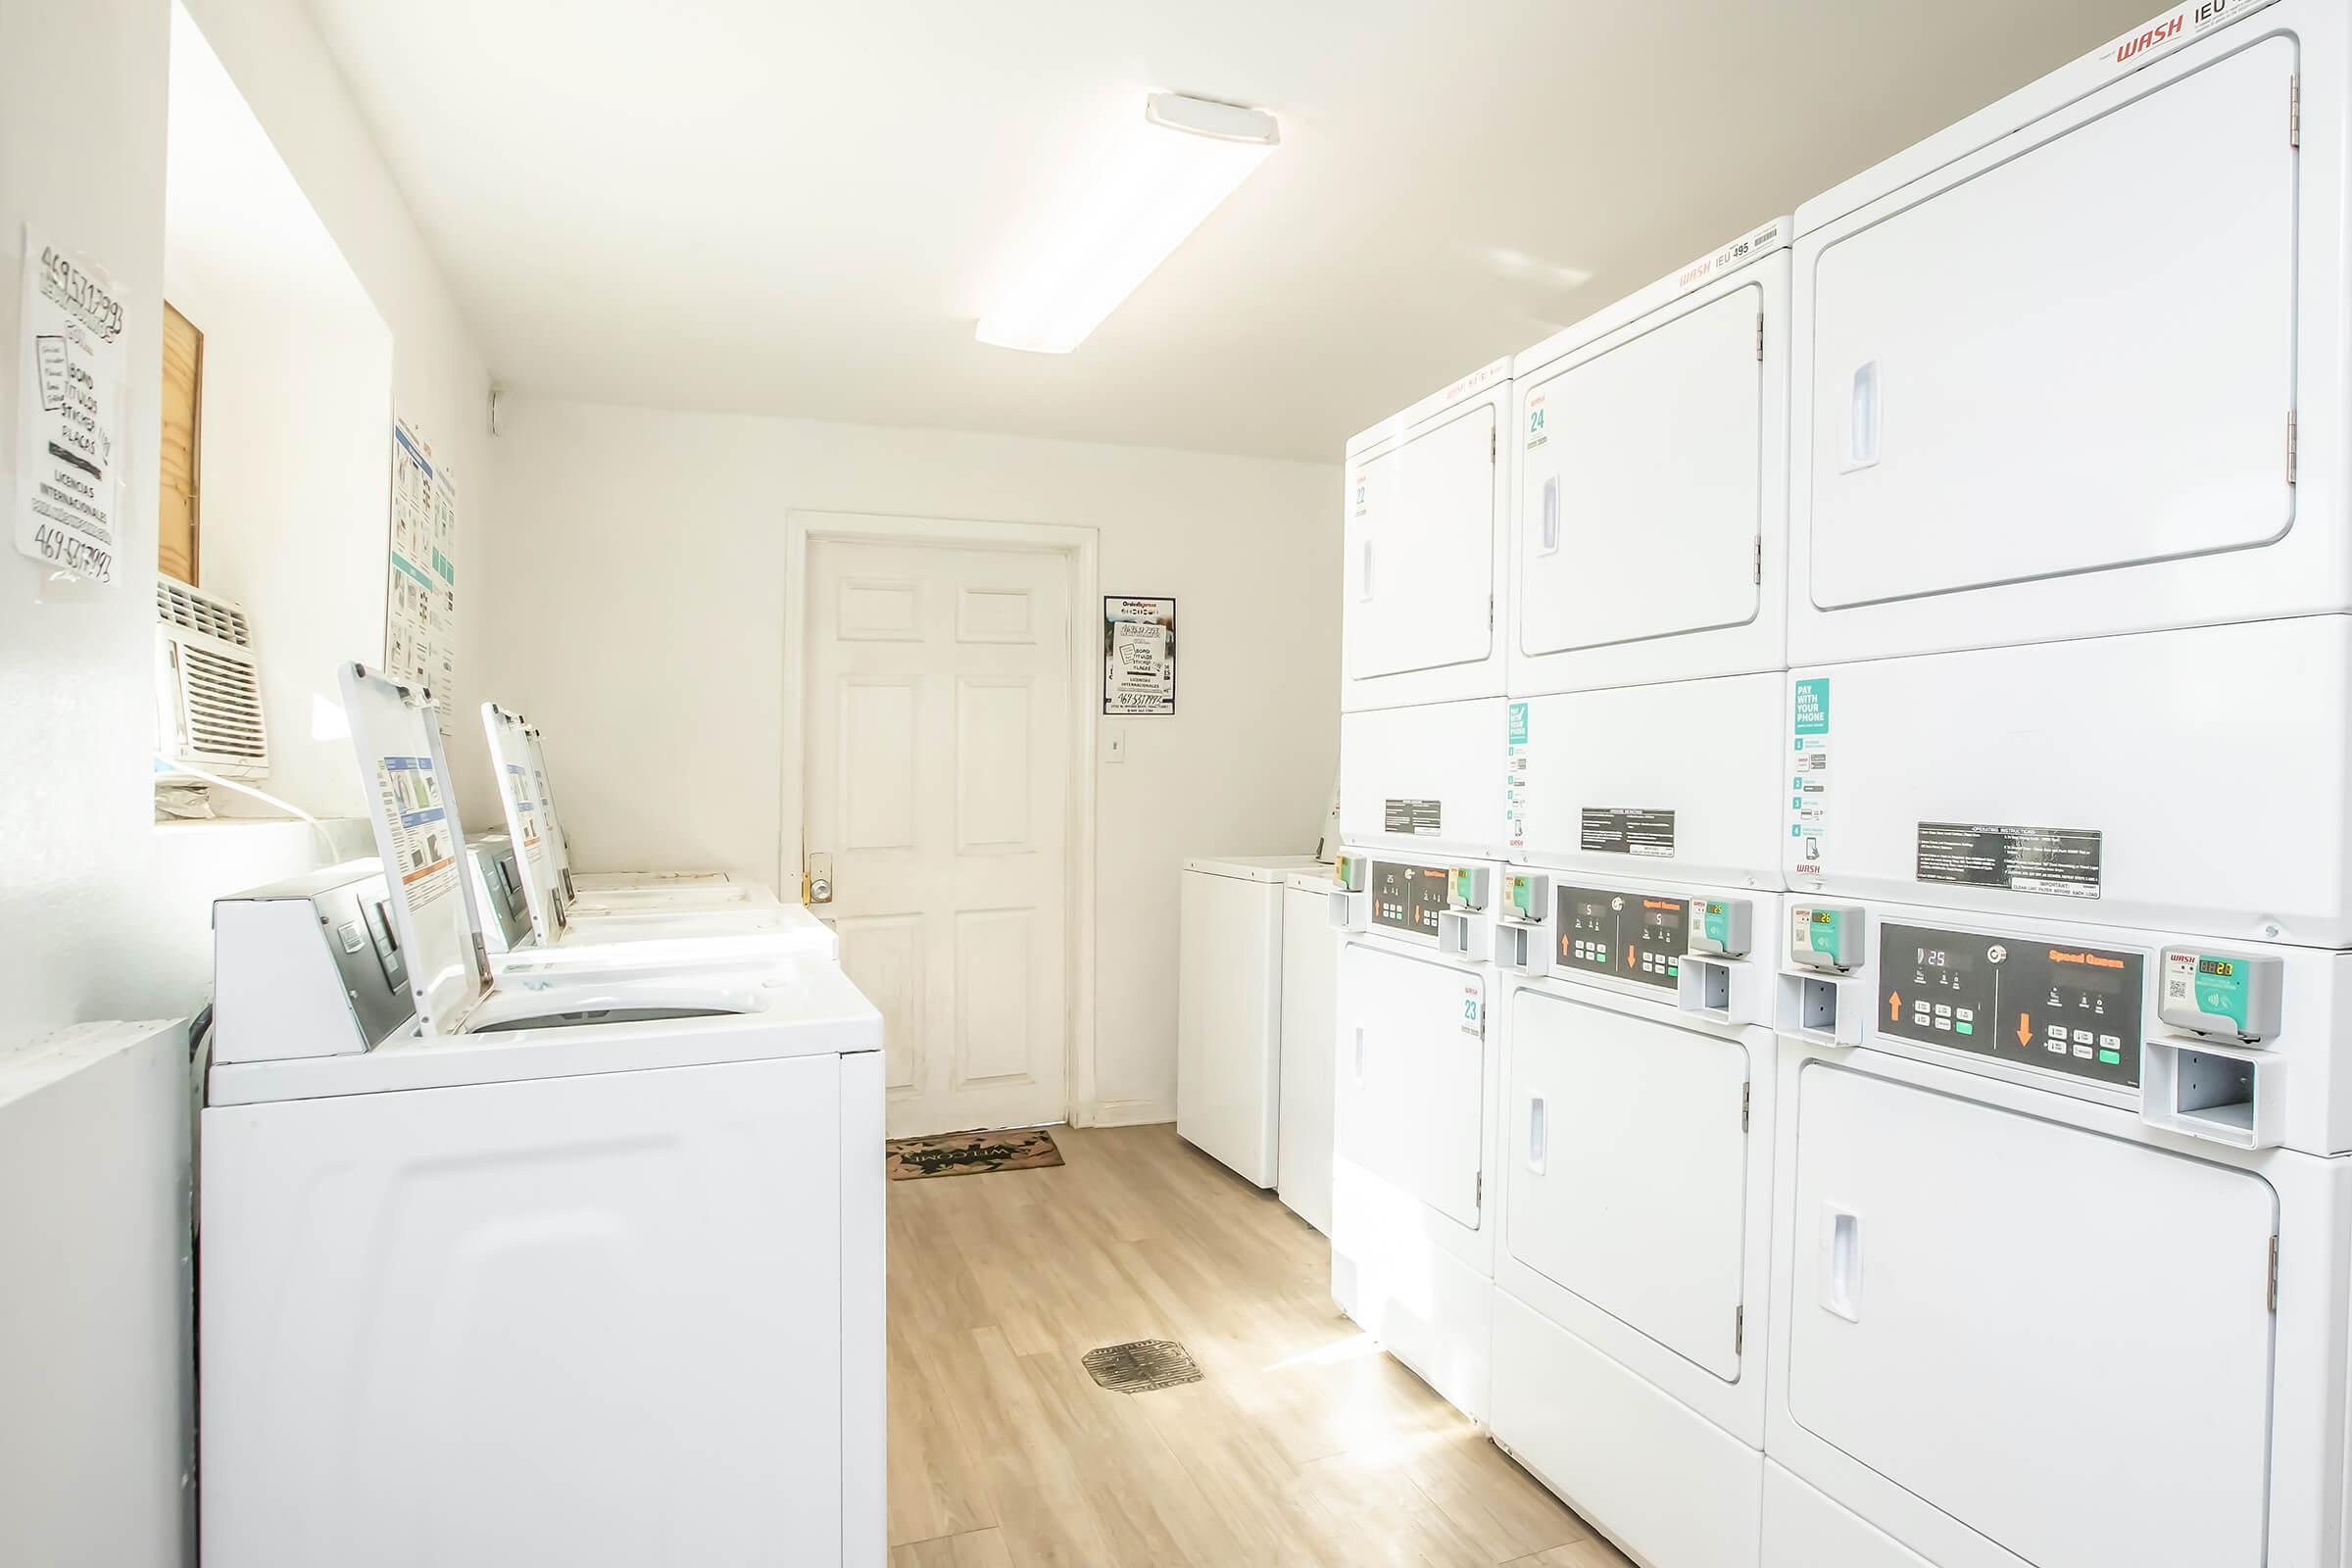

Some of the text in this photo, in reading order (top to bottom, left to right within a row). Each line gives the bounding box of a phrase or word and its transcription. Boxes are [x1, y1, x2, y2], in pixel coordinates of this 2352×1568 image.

[2195, 0, 2226, 24] IEU
[2117, 15, 2183, 63] WASH
[1716, 241, 1749, 268] IEU 495
[1679, 260, 1711, 287] WASH
[1531, 408, 1544, 432] 24
[62, 424, 95, 455] PLACAS
[54, 469, 95, 498] LICENCIAS
[1797, 686, 1812, 695] PAY
[1797, 695, 1818, 704] WITH
[1797, 704, 1819, 712] YOUR
[1797, 712, 1825, 721] PHONE
[1796, 864, 1820, 873] WASH
[1929, 951, 1945, 966] 25
[2049, 949, 2125, 968] Speed Queen
[2170, 954, 2195, 963] WASH
[1465, 1000, 1477, 1020] 23
